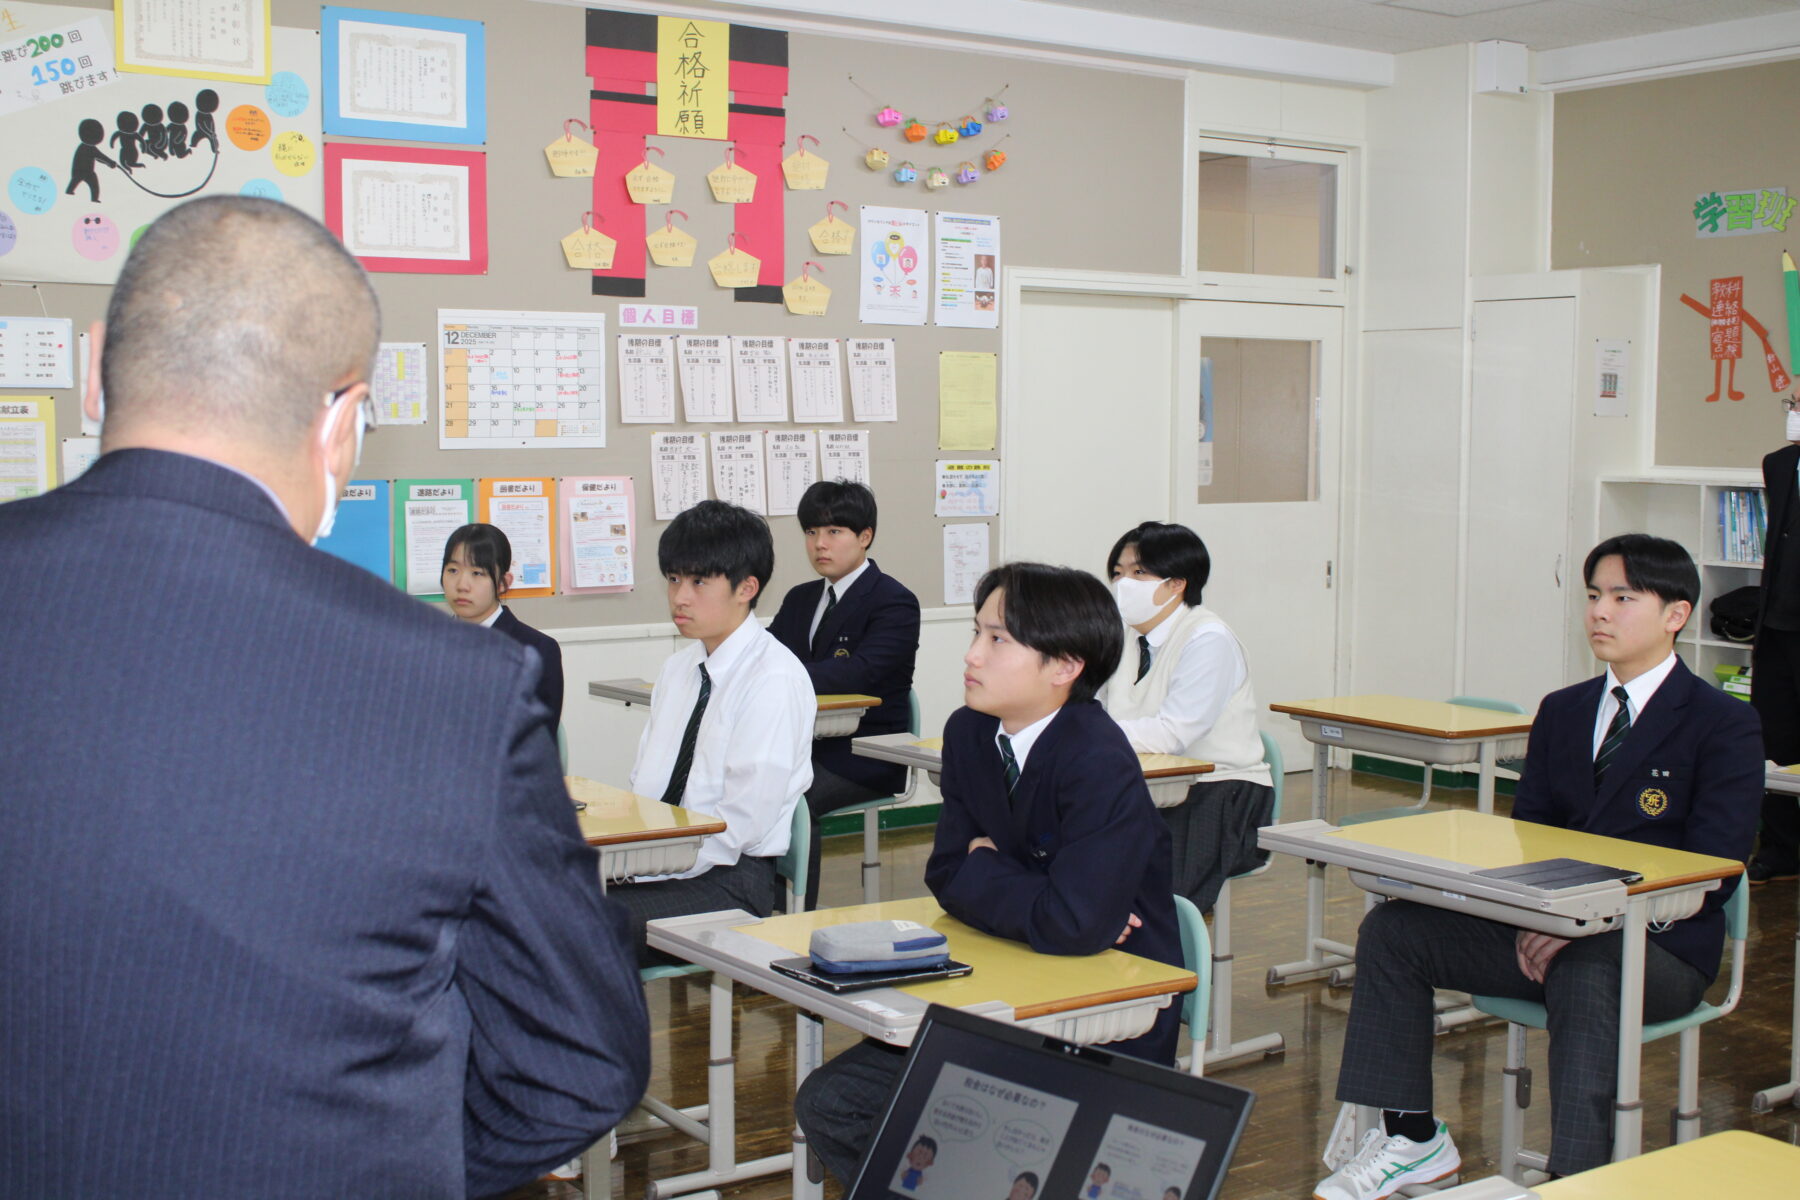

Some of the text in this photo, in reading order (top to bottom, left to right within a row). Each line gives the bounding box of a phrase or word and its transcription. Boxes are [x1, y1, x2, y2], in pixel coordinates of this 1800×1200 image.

[0, 30, 83, 63] 跳び200回
[31, 55, 93, 86] 150回
[674, 21, 710, 135] 合格祈願
[1692, 188, 1798, 233] 学習班
[622, 307, 695, 325] 個人目標
[445, 331, 460, 345] 12
[628, 338, 662, 347] 後期の目標
[686, 339, 719, 348] 後期の目標
[742, 340, 774, 348] 後期の目標
[798, 342, 829, 350] 後期の目標
[855, 342, 885, 350] 後期の目標
[0, 405, 30, 416] 献立表
[663, 435, 695, 444] 後期の目標
[719, 434, 752, 443] 後期の目標
[774, 434, 806, 442] 後期の目標
[417, 488, 455, 498] 進路だより
